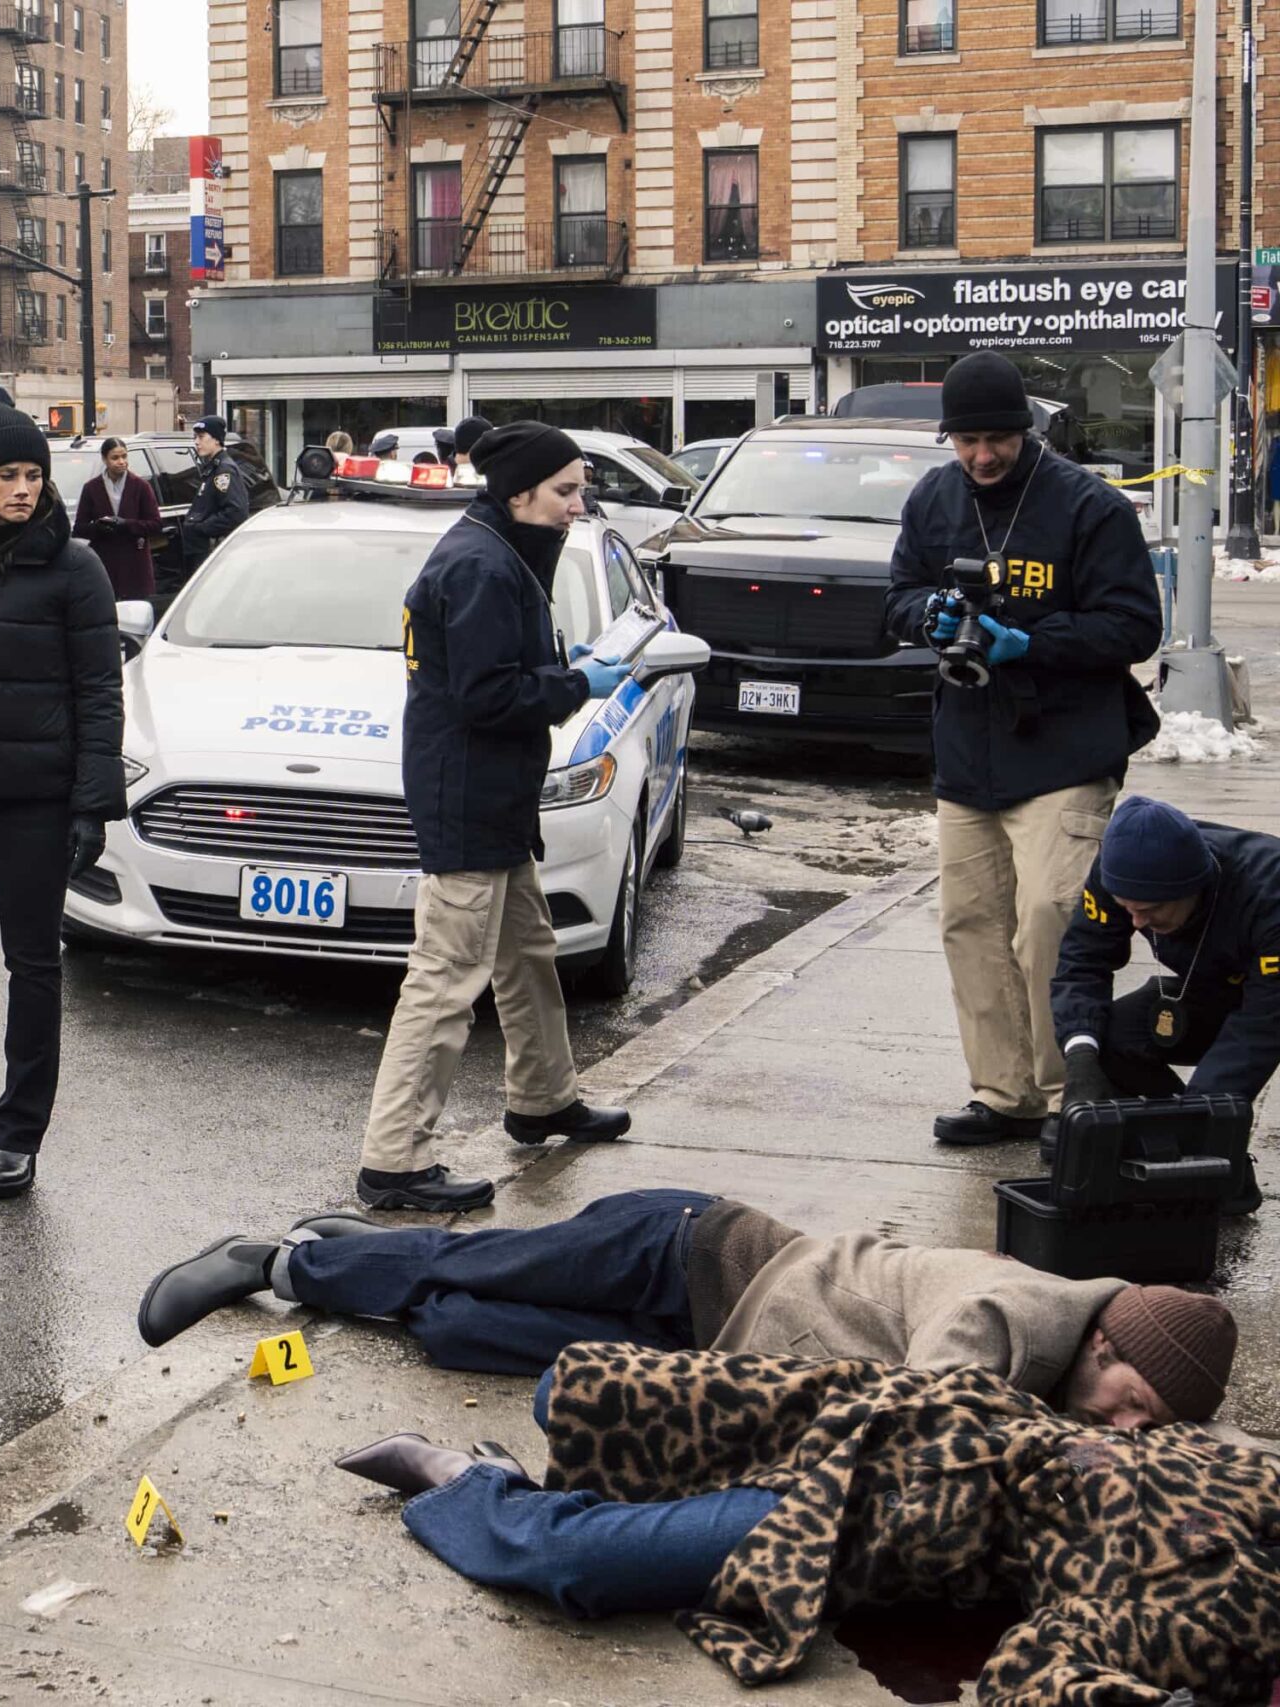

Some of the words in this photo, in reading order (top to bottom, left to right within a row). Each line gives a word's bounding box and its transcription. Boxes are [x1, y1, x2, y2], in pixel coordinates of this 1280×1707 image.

[953, 277, 1071, 304] flatbush
[1080, 280, 1133, 306] eye
[1142, 279, 1187, 300] car
[872, 293, 915, 308] eyepic
[825, 314, 901, 340] optical
[913, 312, 1032, 337] optometry
[1044, 308, 1223, 335] ophthalmoloy
[396, 341, 433, 350] FLATBUSH
[434, 341, 451, 349] AVE
[458, 334, 508, 343] CANNABIS
[512, 332, 570, 342] DISPENSARY
[598, 336, 652, 345] 718-362-2190
[829, 340, 881, 349] 718.223.5707
[969, 336, 1073, 347] eyepiceyecare.com
[1139, 334, 1160, 343] 1054
[1006, 559, 1054, 590] FBI
[1011, 586, 1044, 600] ERT
[270, 704, 373, 721] NYPD
[241, 716, 390, 739] POLICE
[251, 875, 335, 919] 8016
[278, 1340, 298, 1371] 2
[136, 1491, 150, 1526] 3
